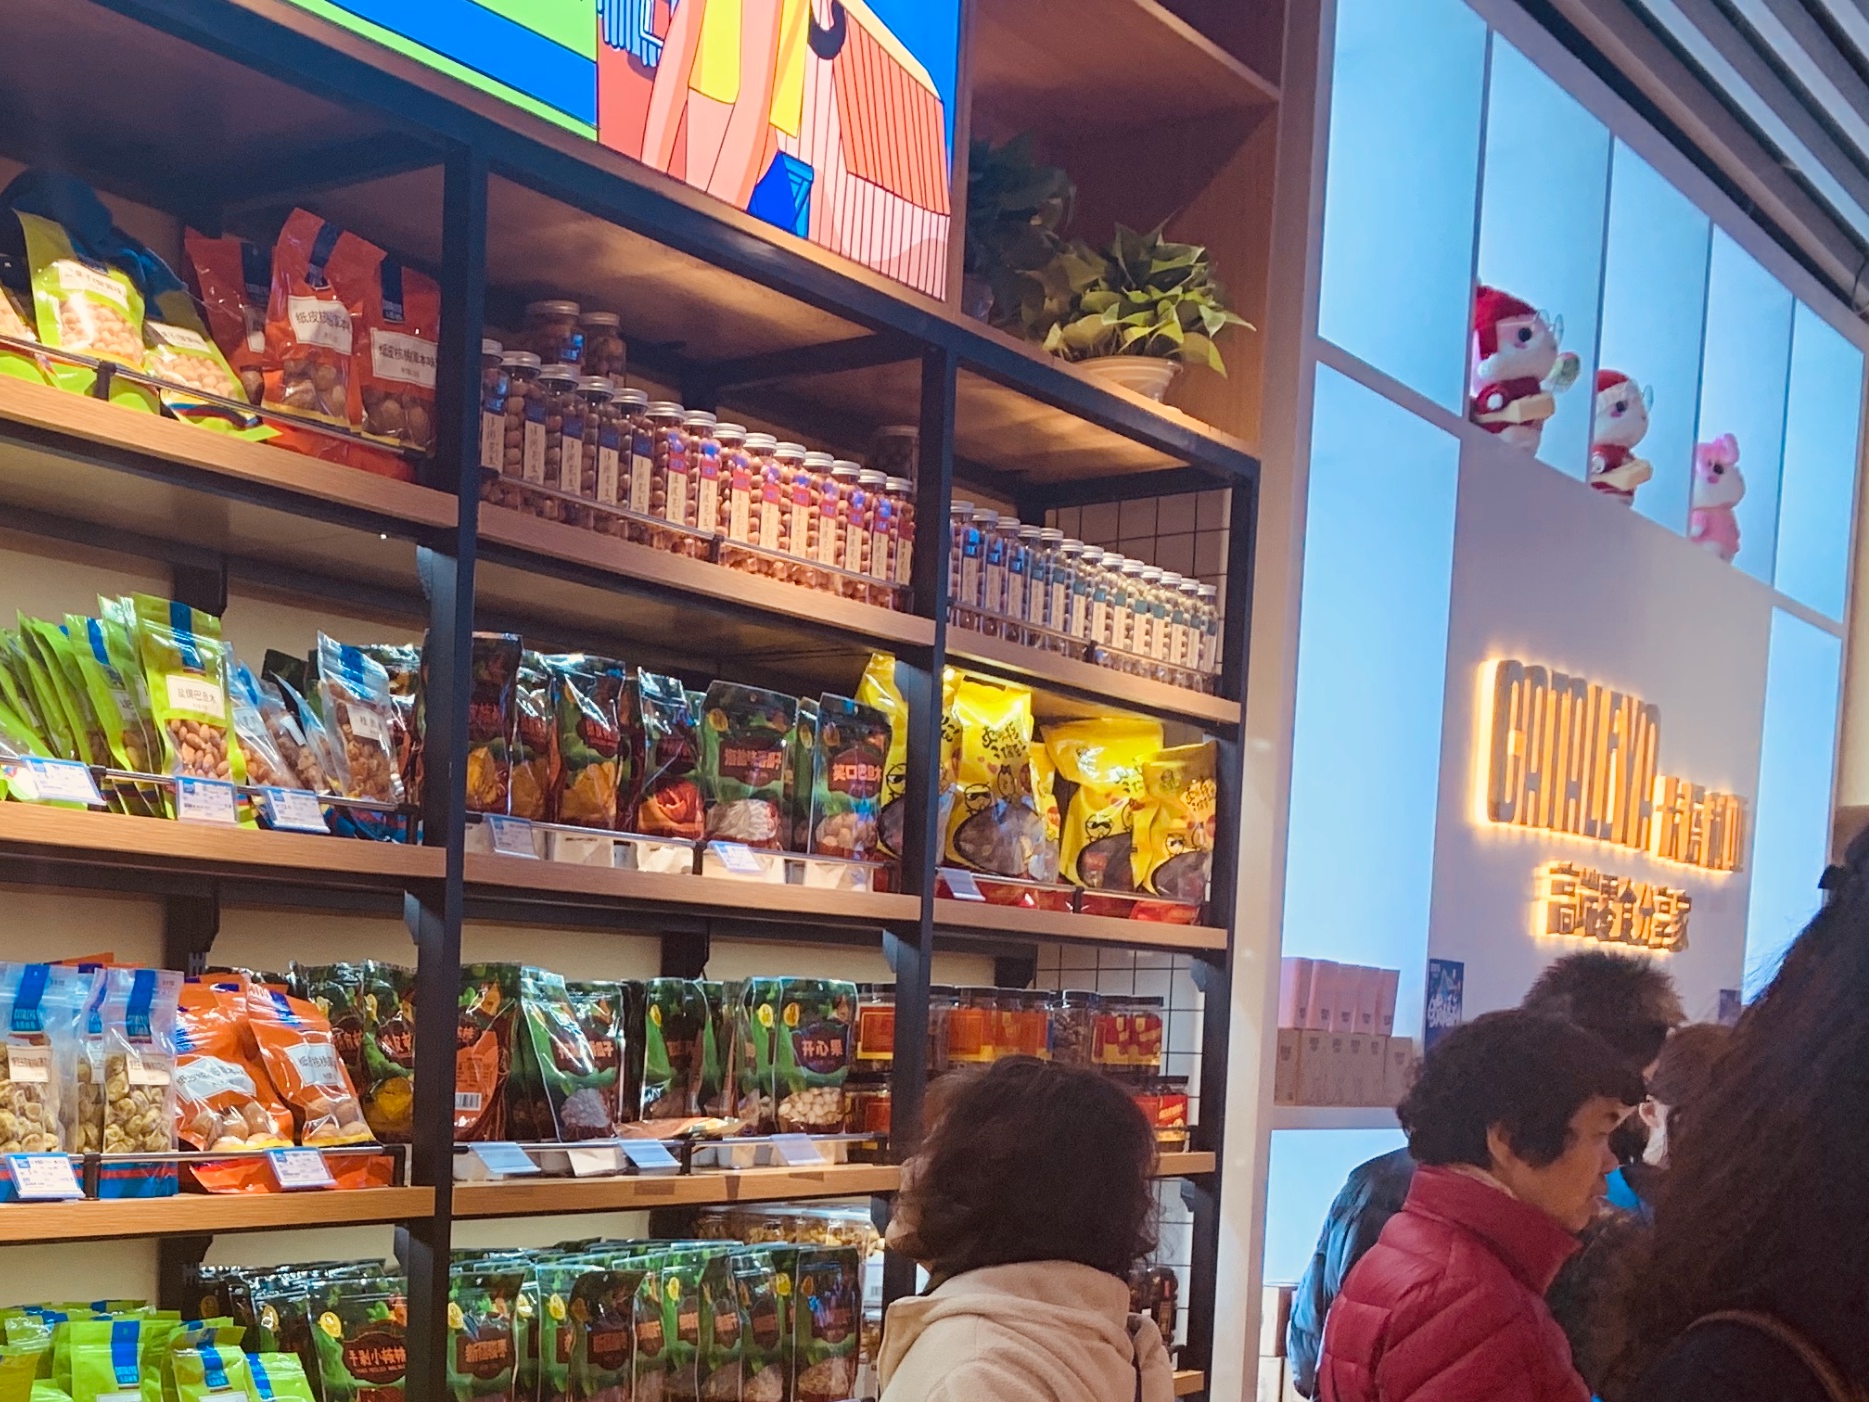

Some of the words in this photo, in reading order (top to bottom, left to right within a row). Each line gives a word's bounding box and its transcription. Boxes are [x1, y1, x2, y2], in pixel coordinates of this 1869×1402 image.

[1487, 659, 1661, 850] CATALEYA
[801, 1038, 843, 1057] 开心果
